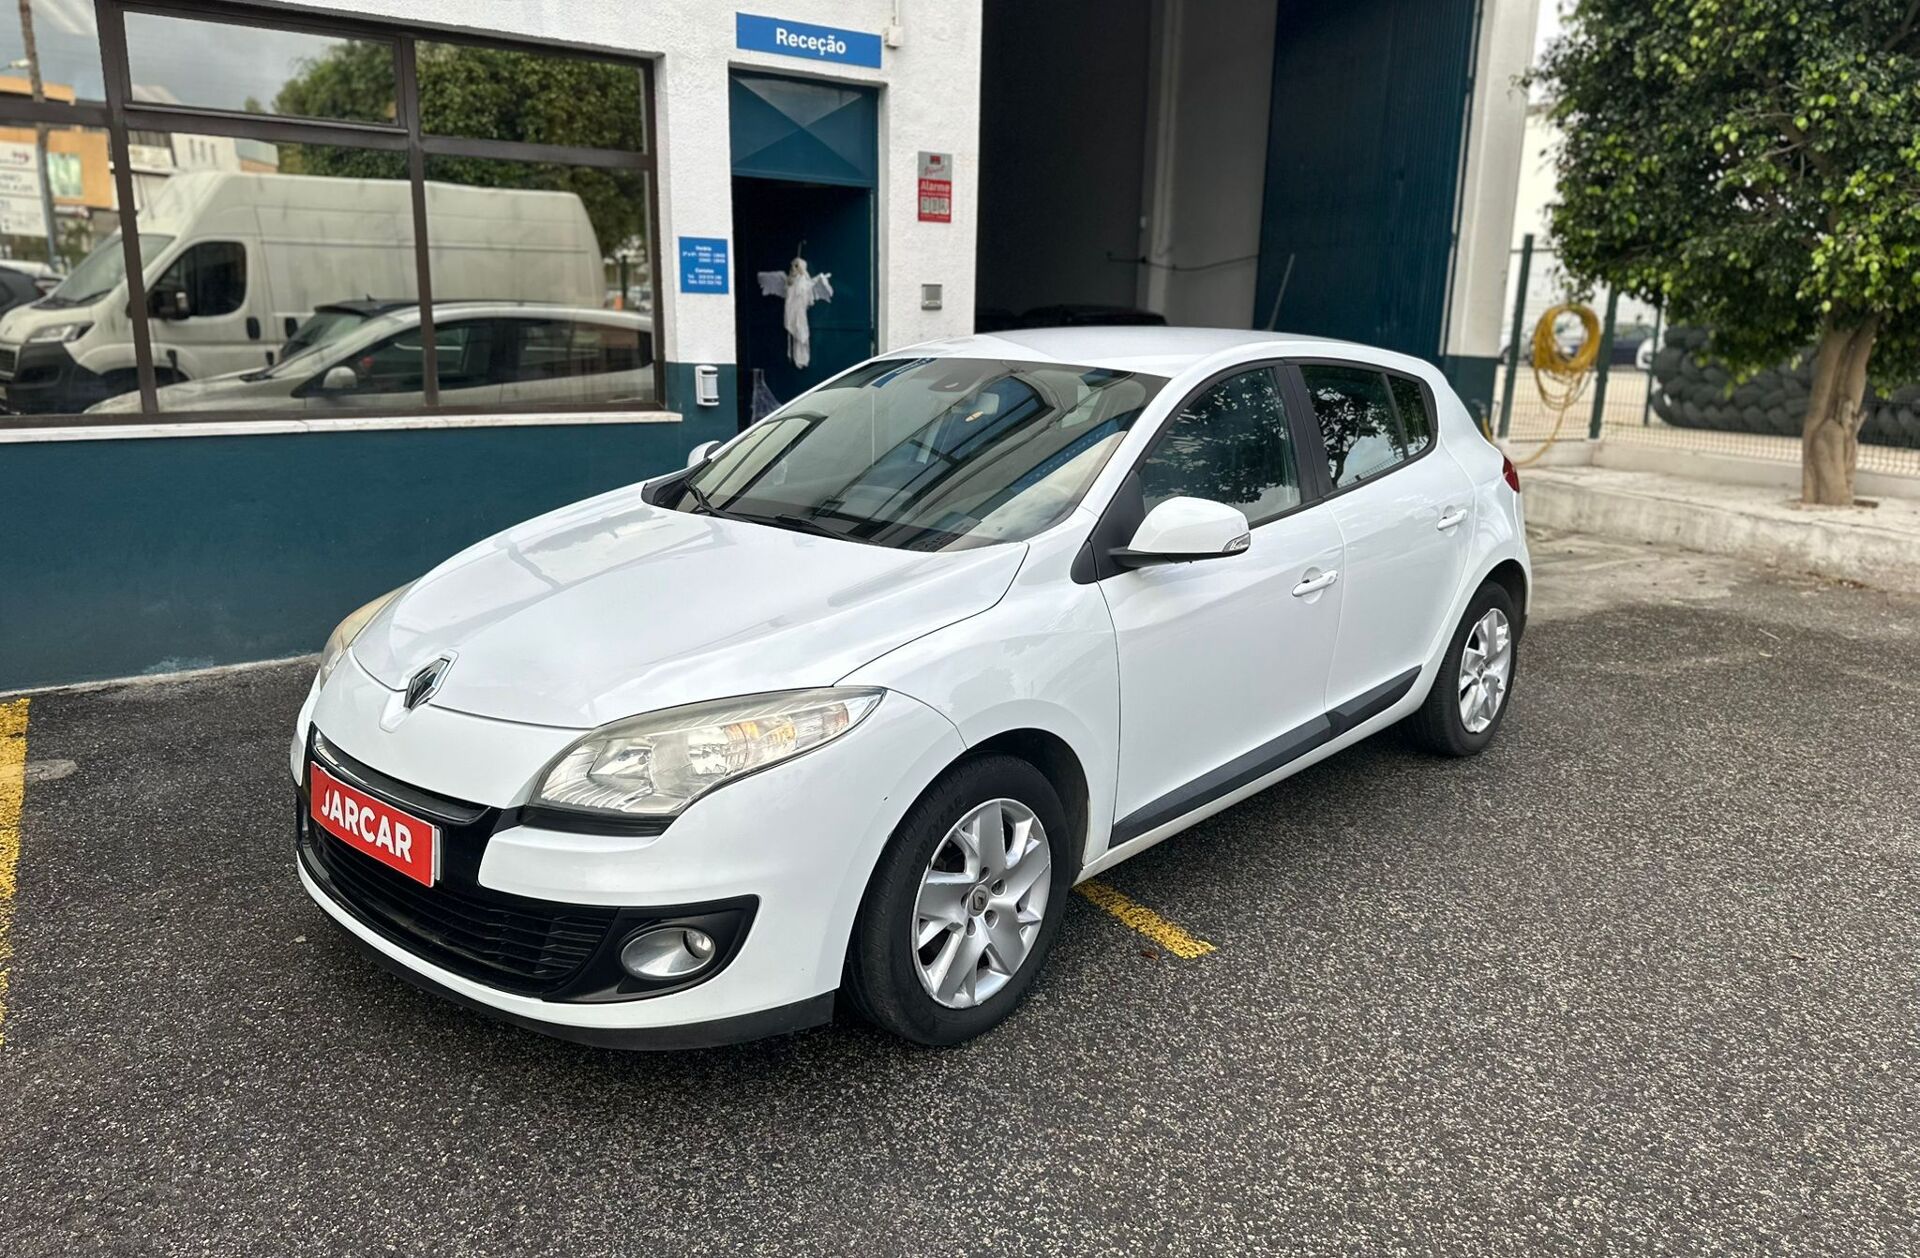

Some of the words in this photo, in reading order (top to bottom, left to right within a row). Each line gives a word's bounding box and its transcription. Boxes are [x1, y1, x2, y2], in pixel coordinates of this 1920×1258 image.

[776, 27, 846, 56] Receção
[920, 180, 950, 192] Alarme
[321, 788, 412, 864] JARCAR
